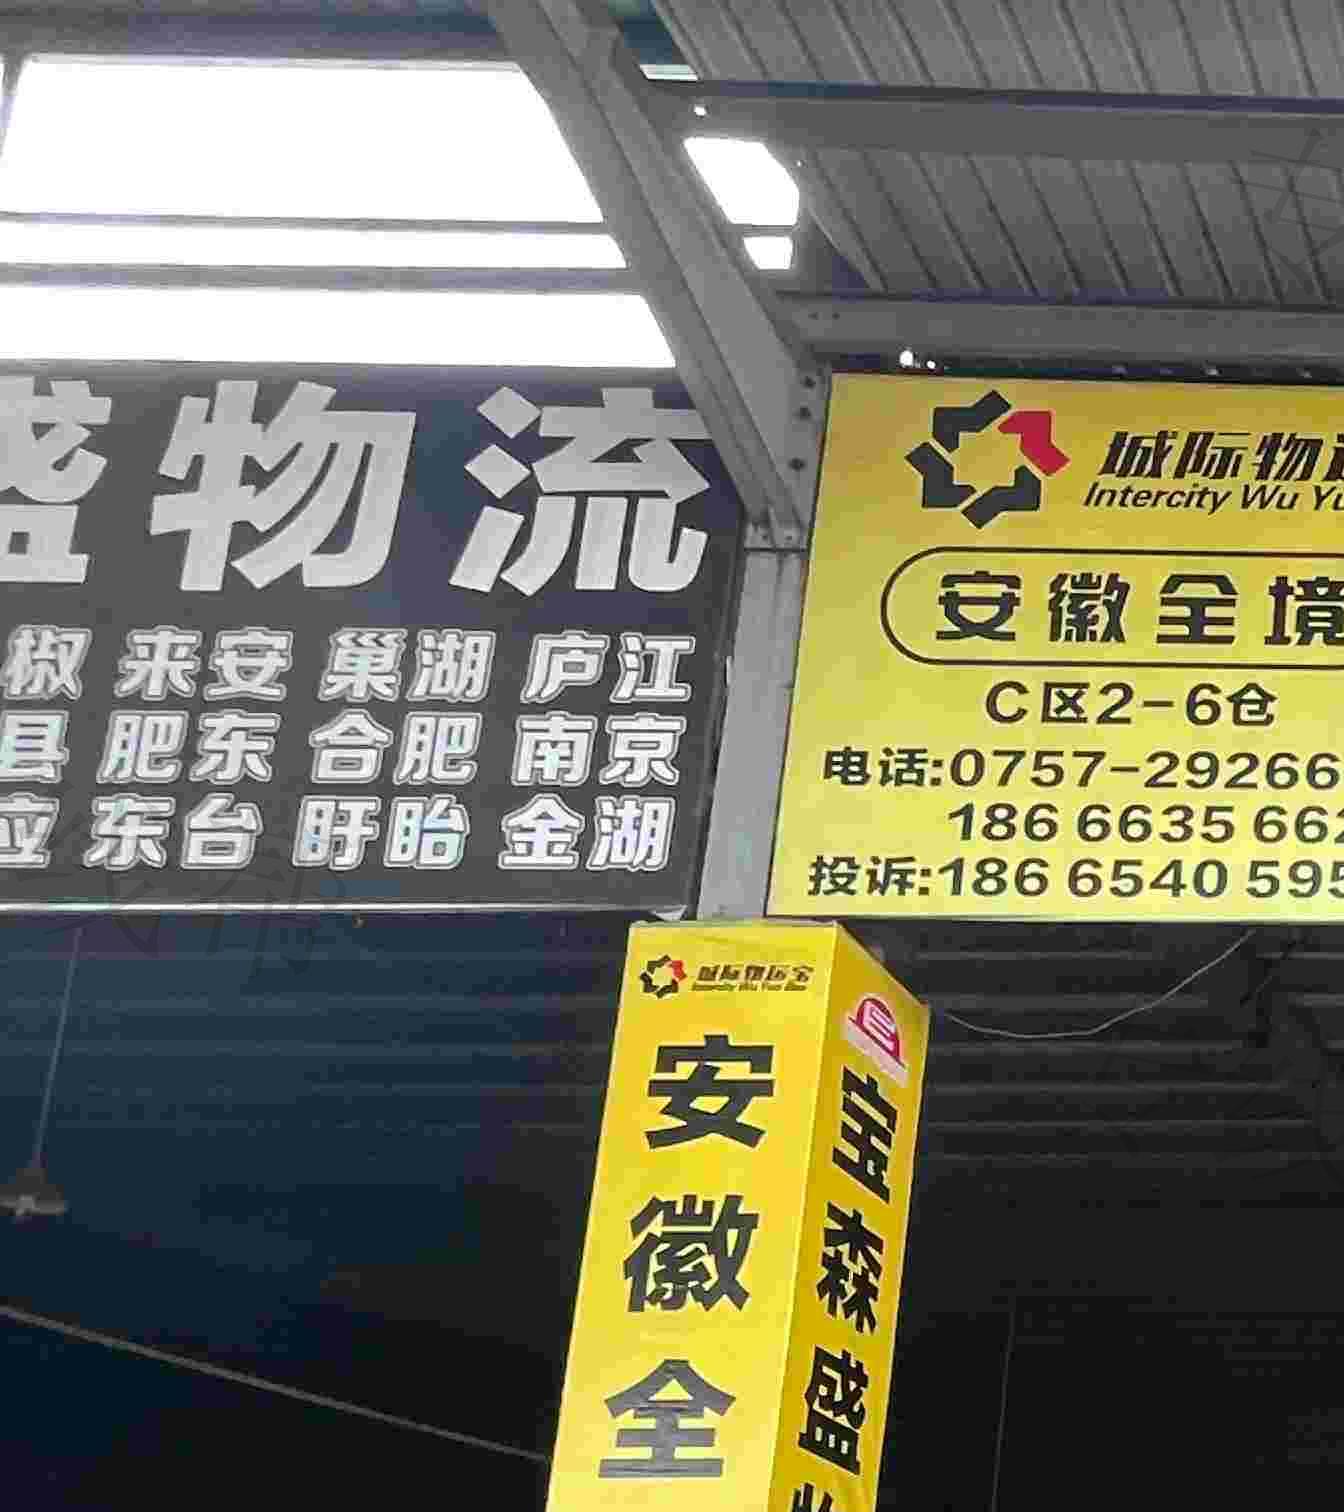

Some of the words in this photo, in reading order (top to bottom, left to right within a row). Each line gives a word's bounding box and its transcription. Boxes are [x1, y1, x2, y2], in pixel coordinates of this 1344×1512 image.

[1083, 482, 1232, 515] Intercity
[1241, 484, 1300, 510] Wu
[116, 628, 292, 699] 来安
[319, 629, 496, 701] 巢湖
[521, 631, 694, 703] 庐江
[985, 680, 1278, 728] C区2-6仓
[97, 709, 280, 783] 肥东
[309, 709, 483, 784] 合肥
[511, 711, 686, 786] 南京
[83, 794, 263, 870] 东台
[292, 794, 470, 870] 盱眙
[499, 794, 677, 872] 金湖
[948, 803, 1058, 843] 186
[1077, 803, 1236, 844] 6635
[1066, 857, 1230, 900] 6540
